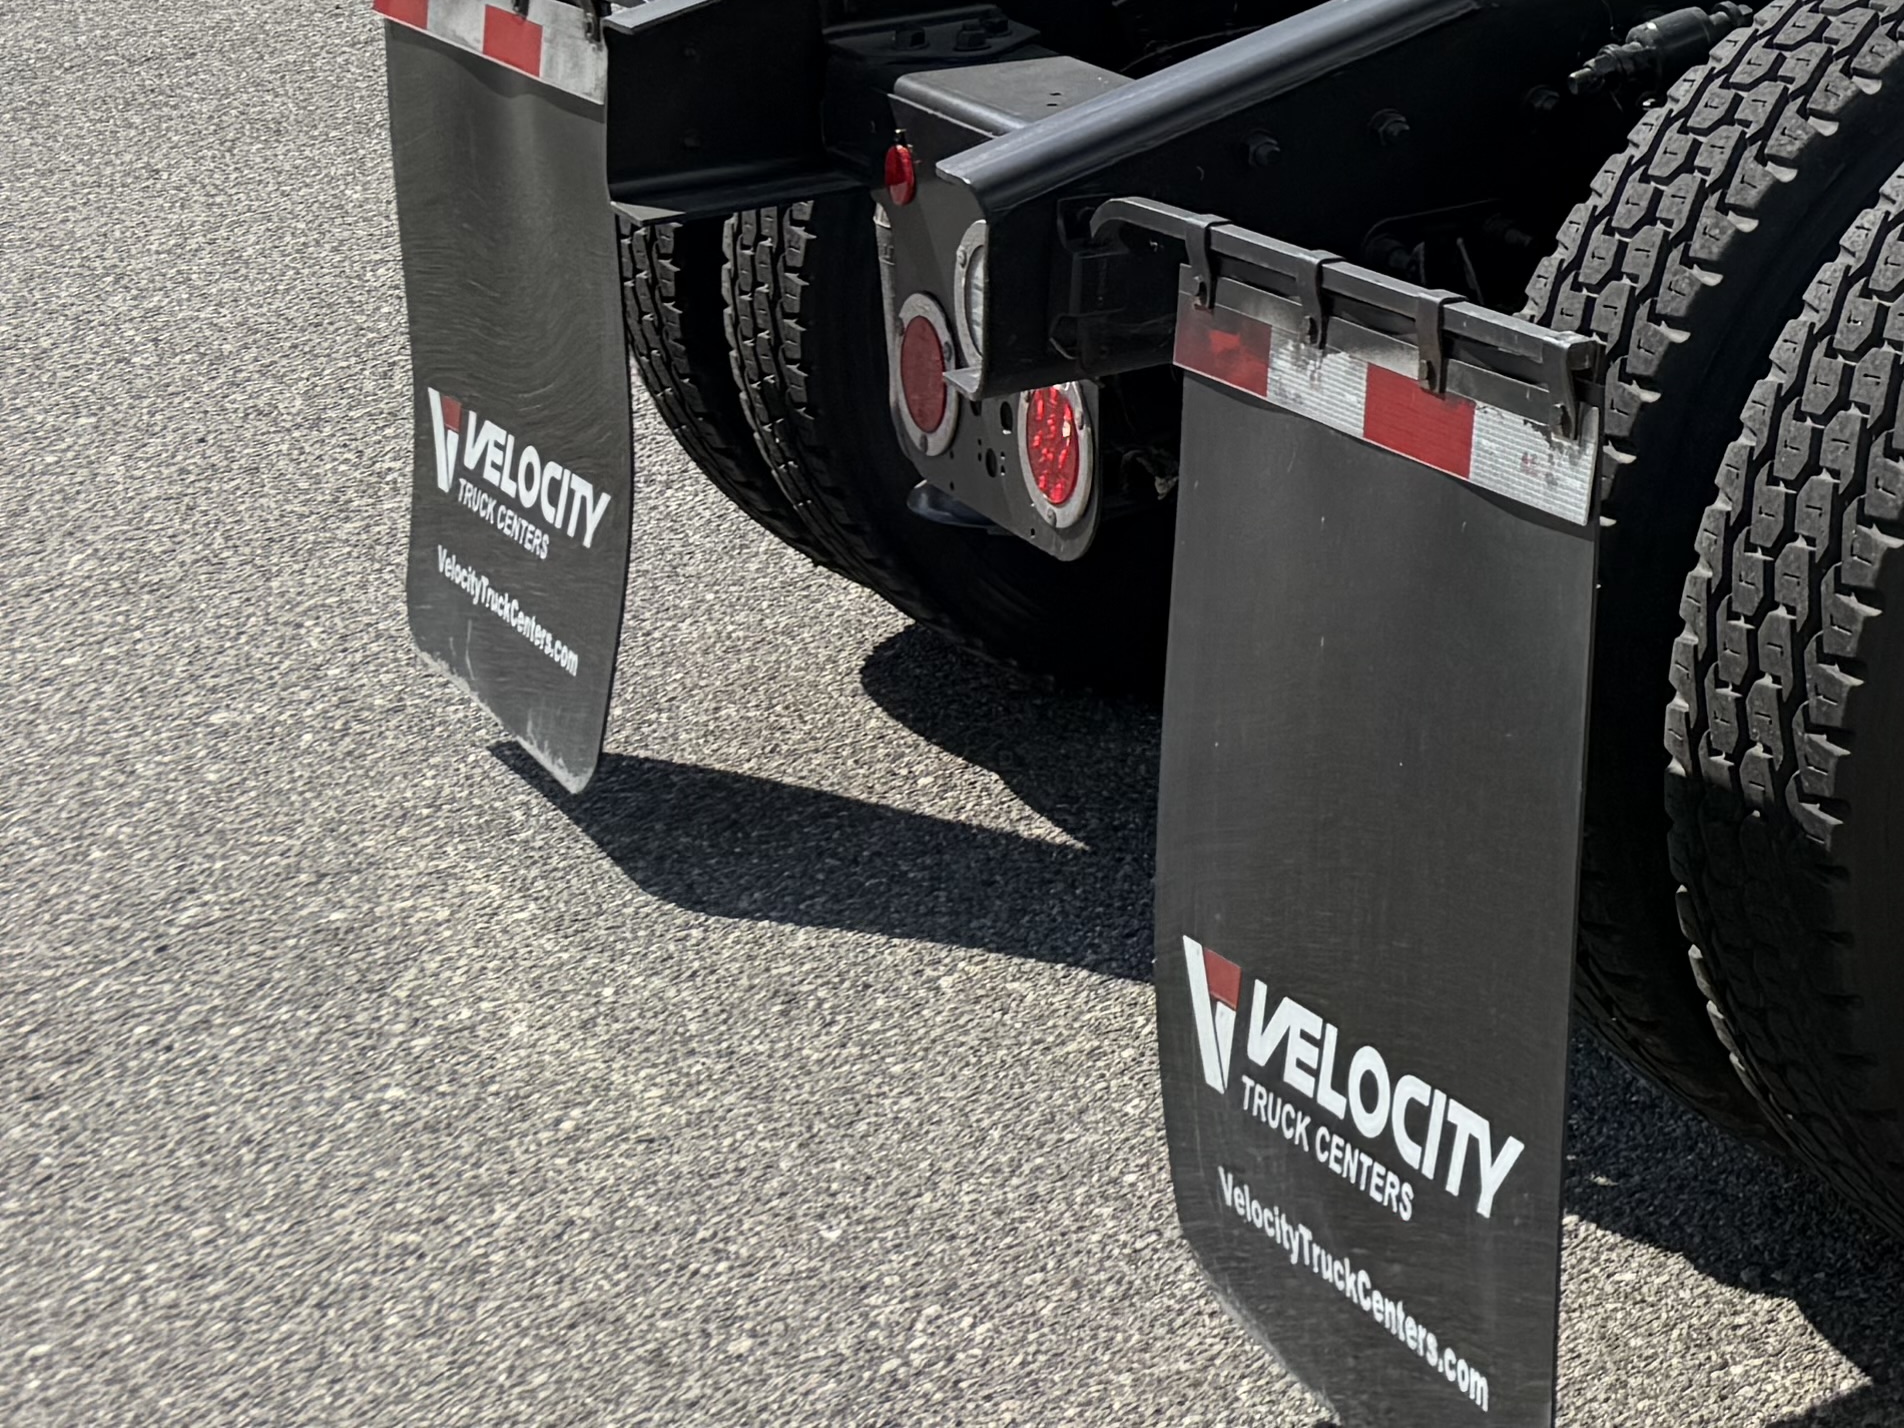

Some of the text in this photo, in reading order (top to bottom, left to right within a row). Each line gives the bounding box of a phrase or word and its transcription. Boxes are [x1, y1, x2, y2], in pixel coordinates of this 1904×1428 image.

[457, 478, 550, 560] TRUCK CENTERS
[463, 410, 612, 549] VELOCITY
[437, 544, 579, 677] VelocityTruckCenters.com
[1241, 1075, 1414, 1222] TRUCK CENTERS
[1246, 978, 1525, 1219] VELOCITY
[1218, 1165, 1489, 1413] VelocityTruckCenters.com
